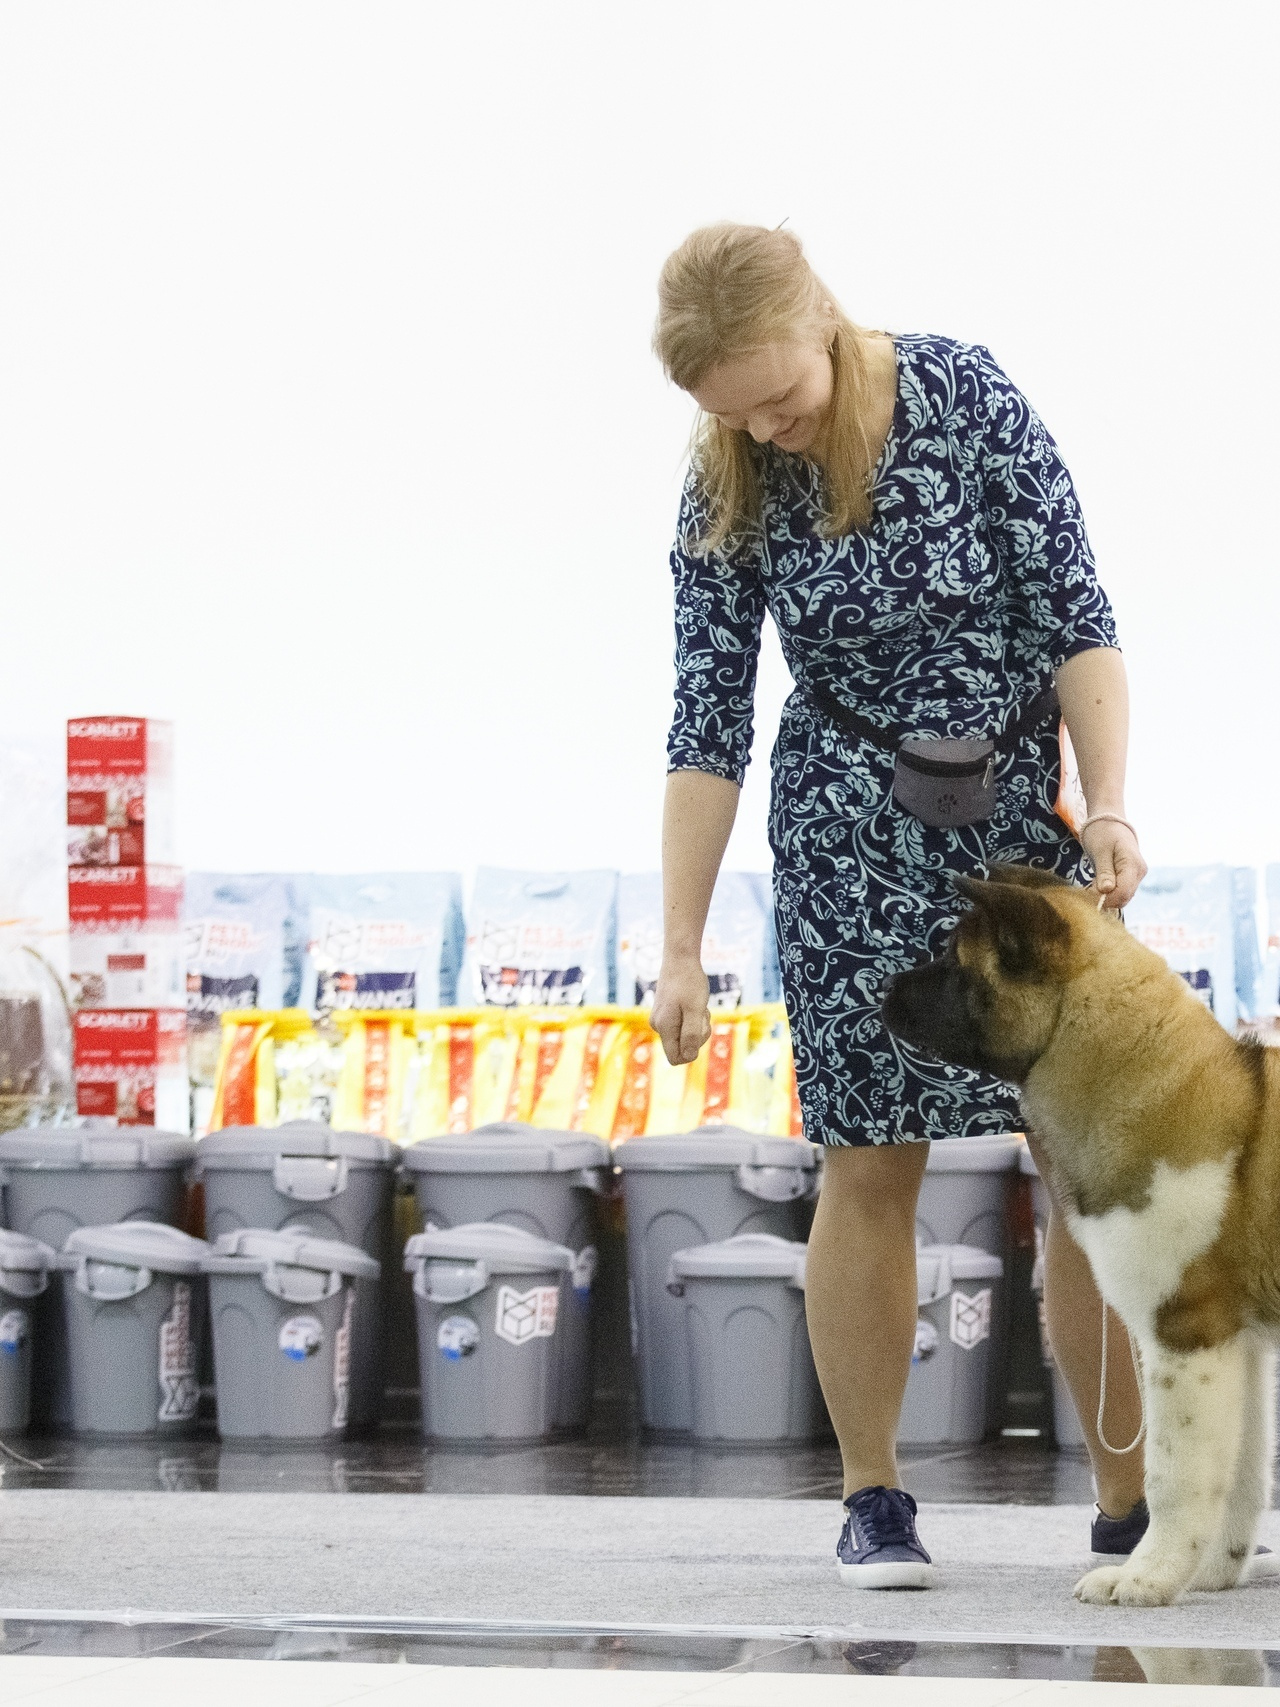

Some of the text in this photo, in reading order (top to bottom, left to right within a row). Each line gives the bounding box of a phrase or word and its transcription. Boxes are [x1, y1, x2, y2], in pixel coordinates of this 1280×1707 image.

[69, 722, 140, 738] SCARLETT
[69, 867, 138, 883] SCARLETT
[79, 1012, 150, 1029] SCARLETT
